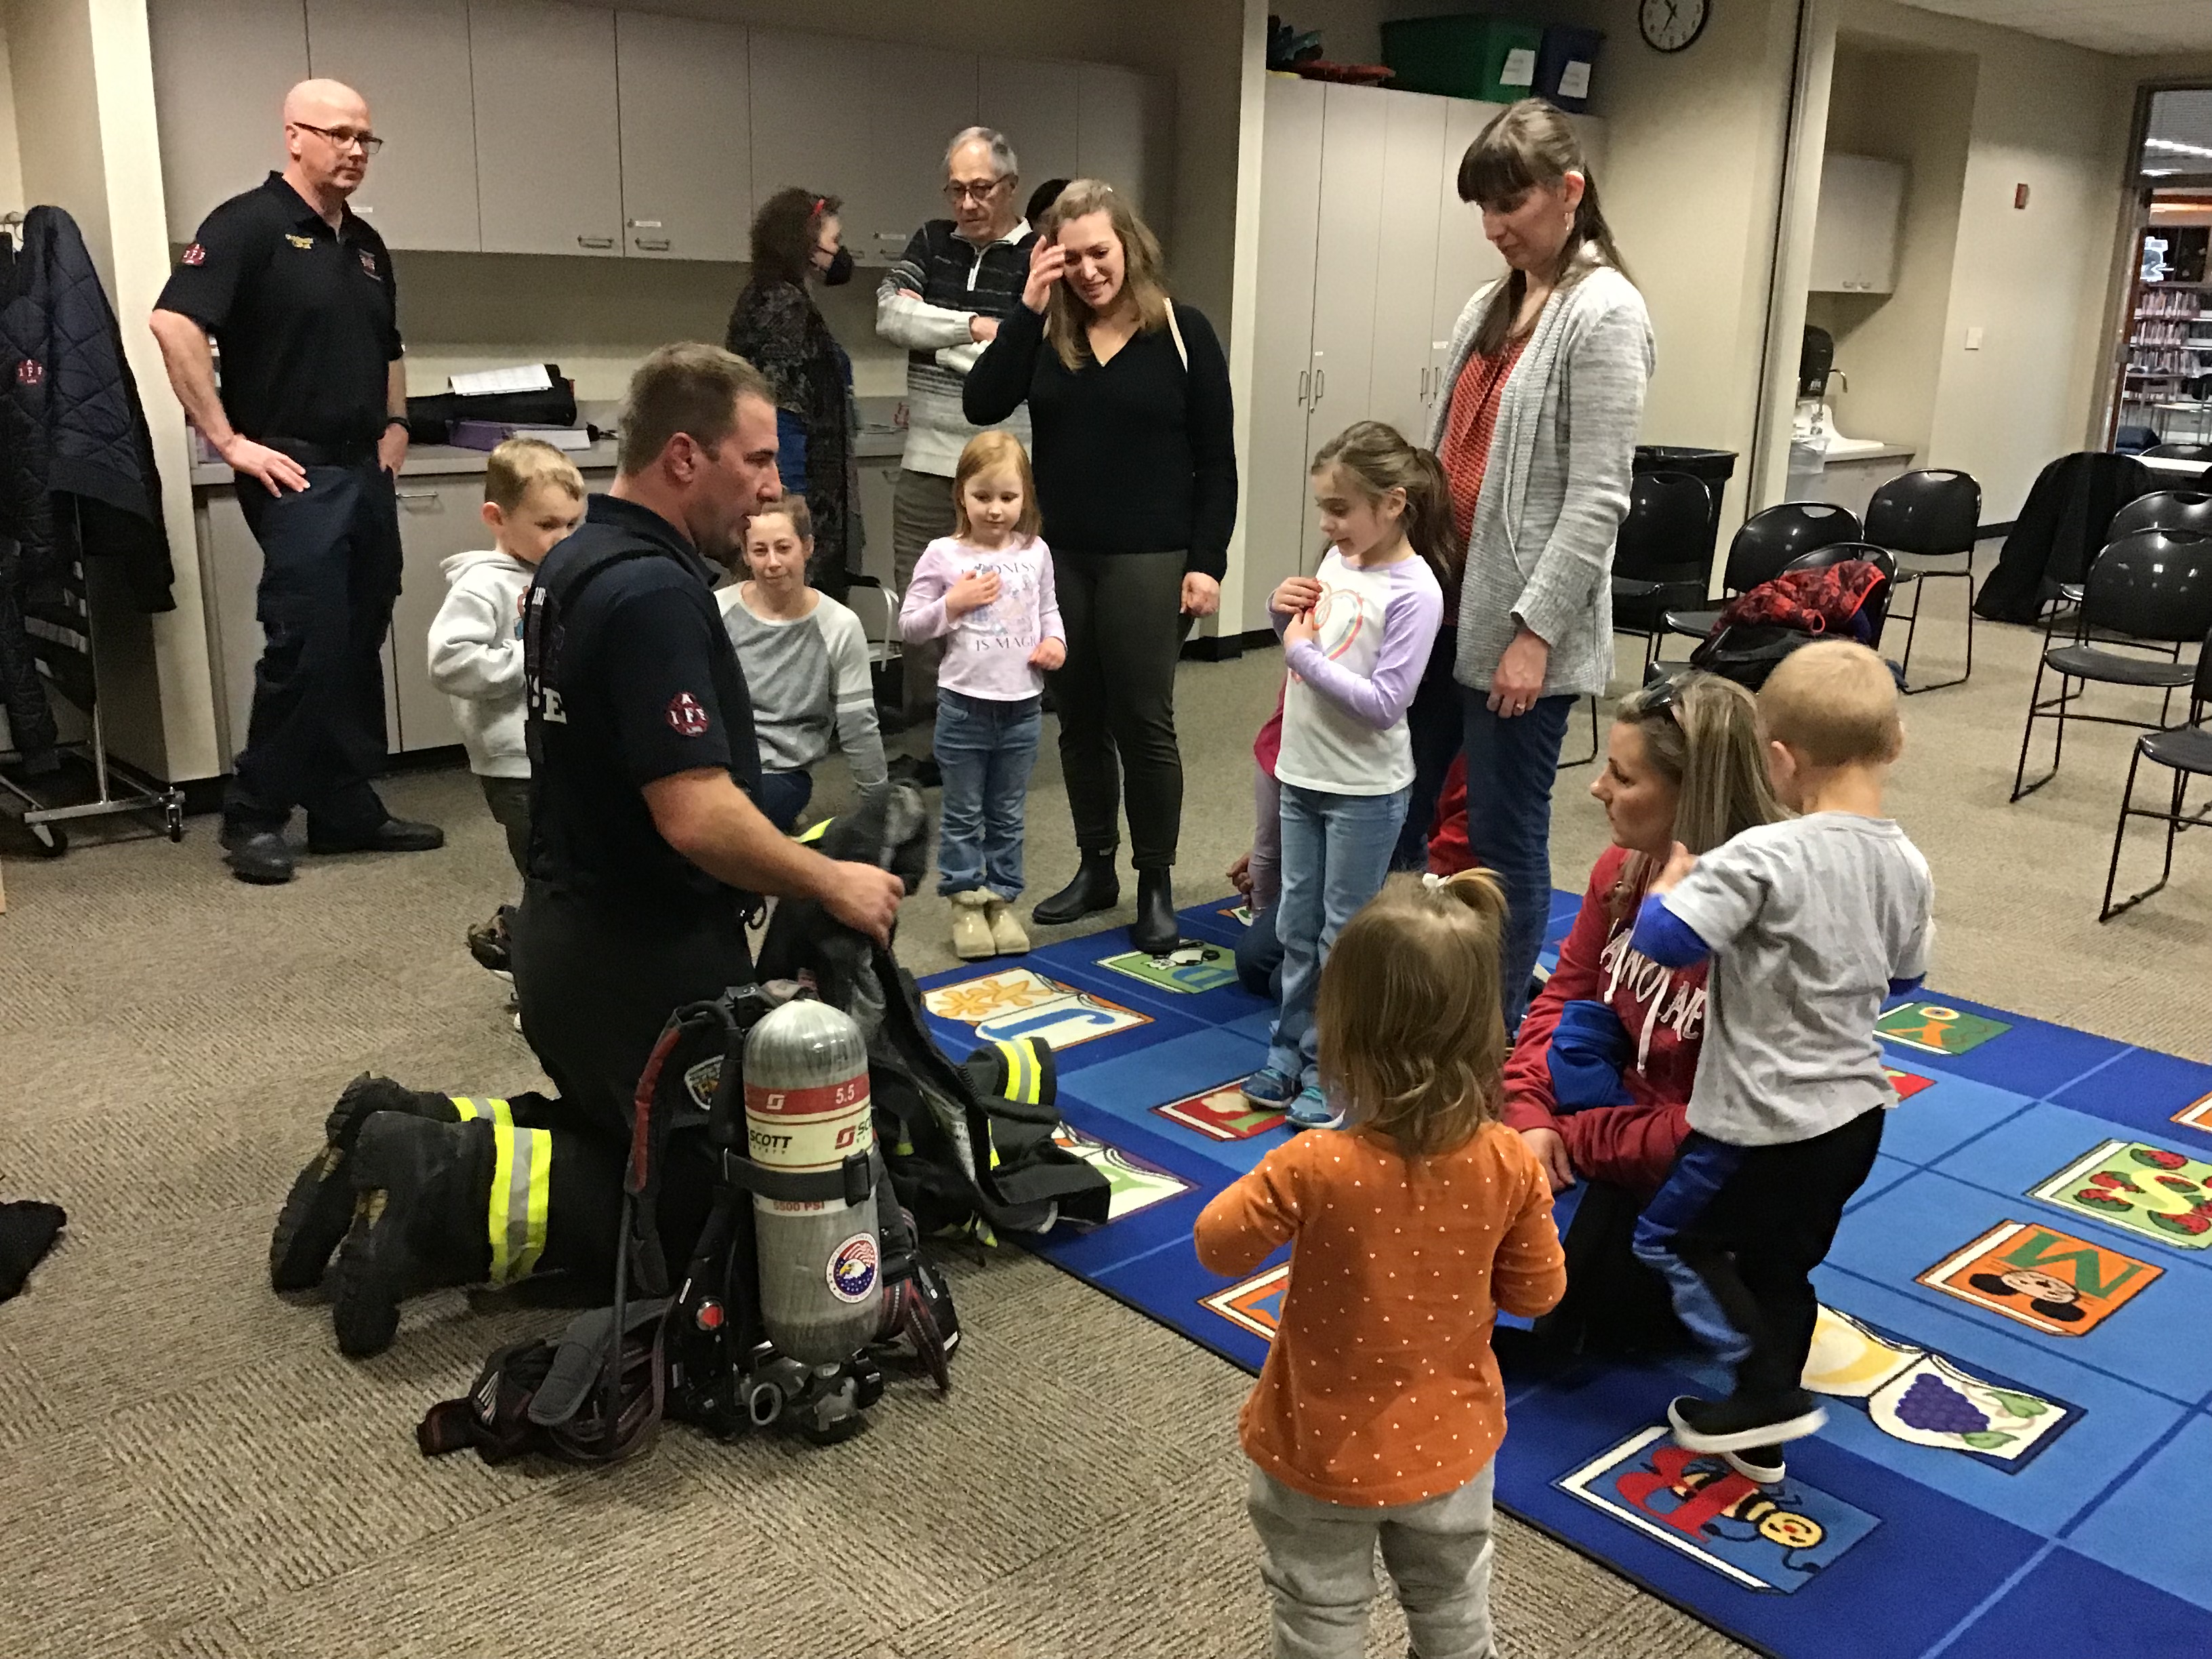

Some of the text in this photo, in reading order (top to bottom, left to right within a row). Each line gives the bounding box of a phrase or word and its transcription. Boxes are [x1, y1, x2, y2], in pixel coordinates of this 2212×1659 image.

[976, 640, 989, 651] IS
[835, 1084, 855, 1105] 5.5
[749, 1129, 793, 1149] SCOTT
[773, 1200, 825, 1212] 5500 PSI
